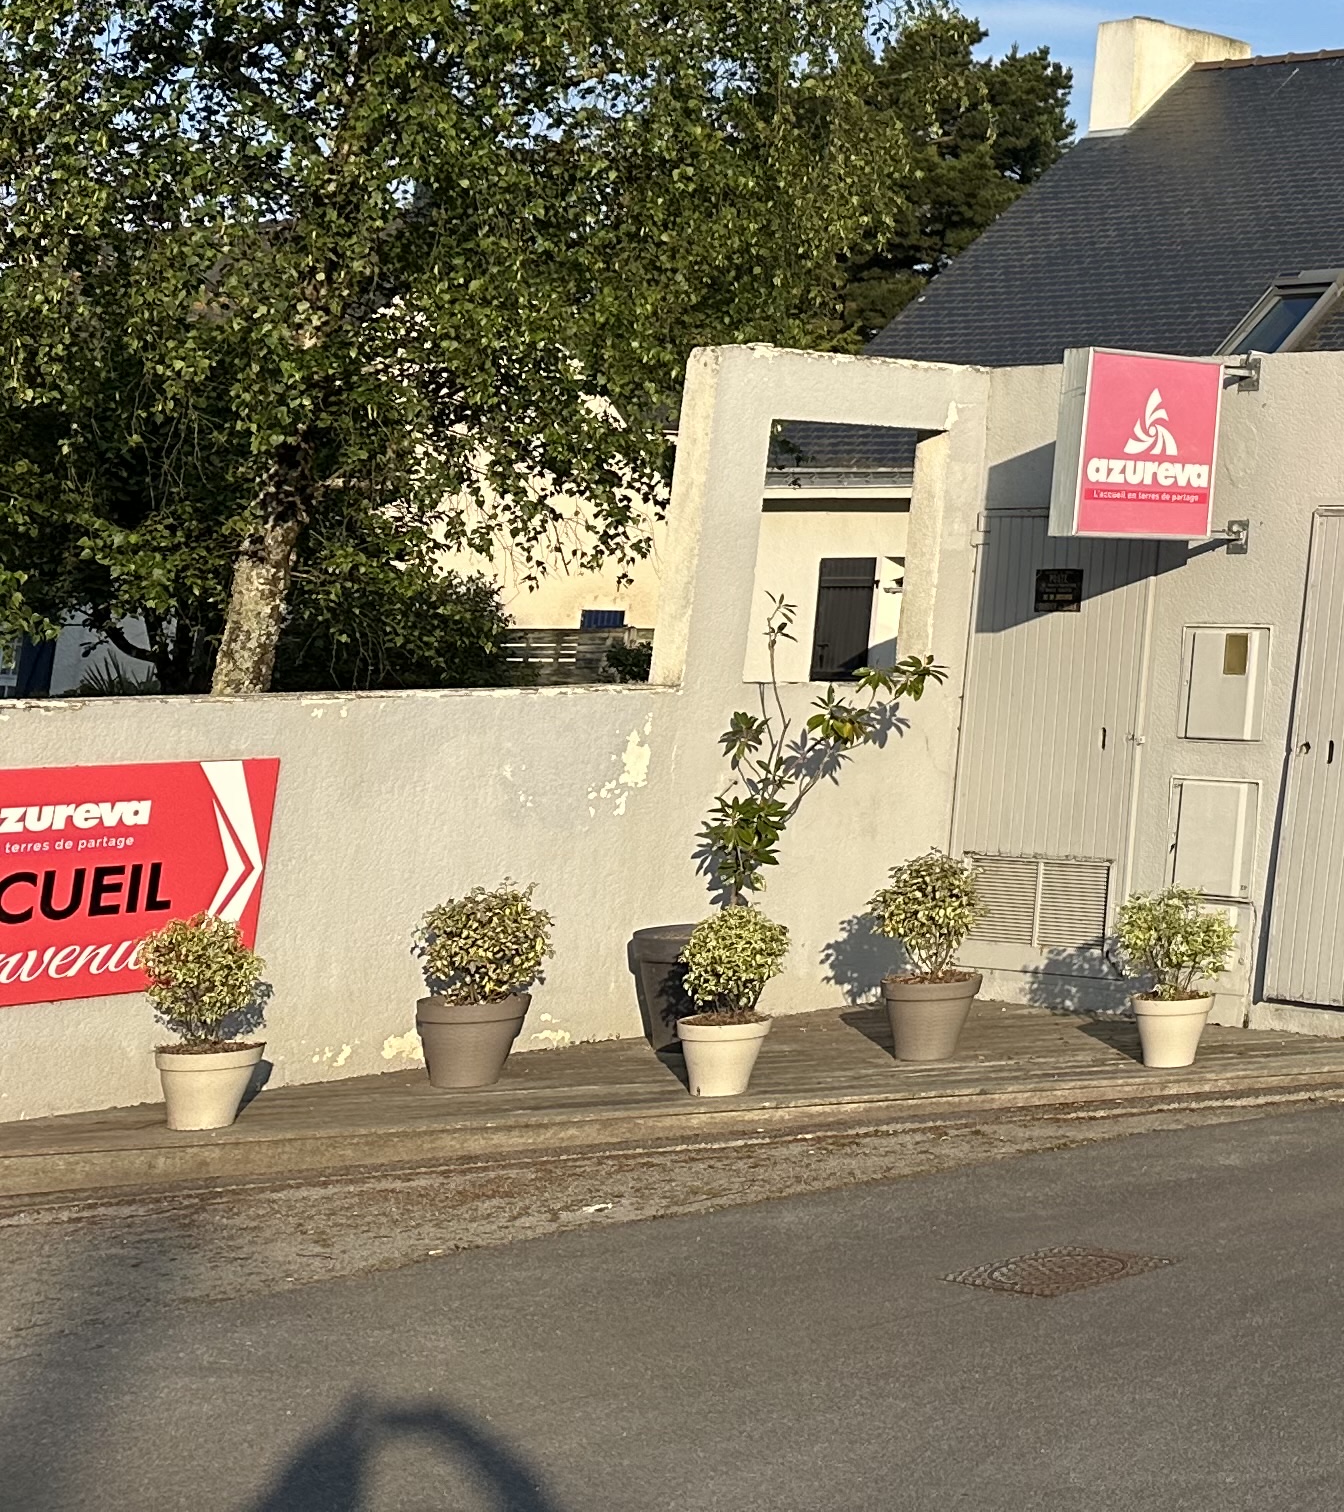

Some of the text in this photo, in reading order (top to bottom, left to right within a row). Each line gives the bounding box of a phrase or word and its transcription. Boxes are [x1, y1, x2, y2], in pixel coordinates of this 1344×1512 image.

[1086, 457, 1210, 488] azureva
[0, 800, 152, 833] zureva
[5, 836, 135, 854] terres de partage
[0, 862, 172, 925] CUEIL
